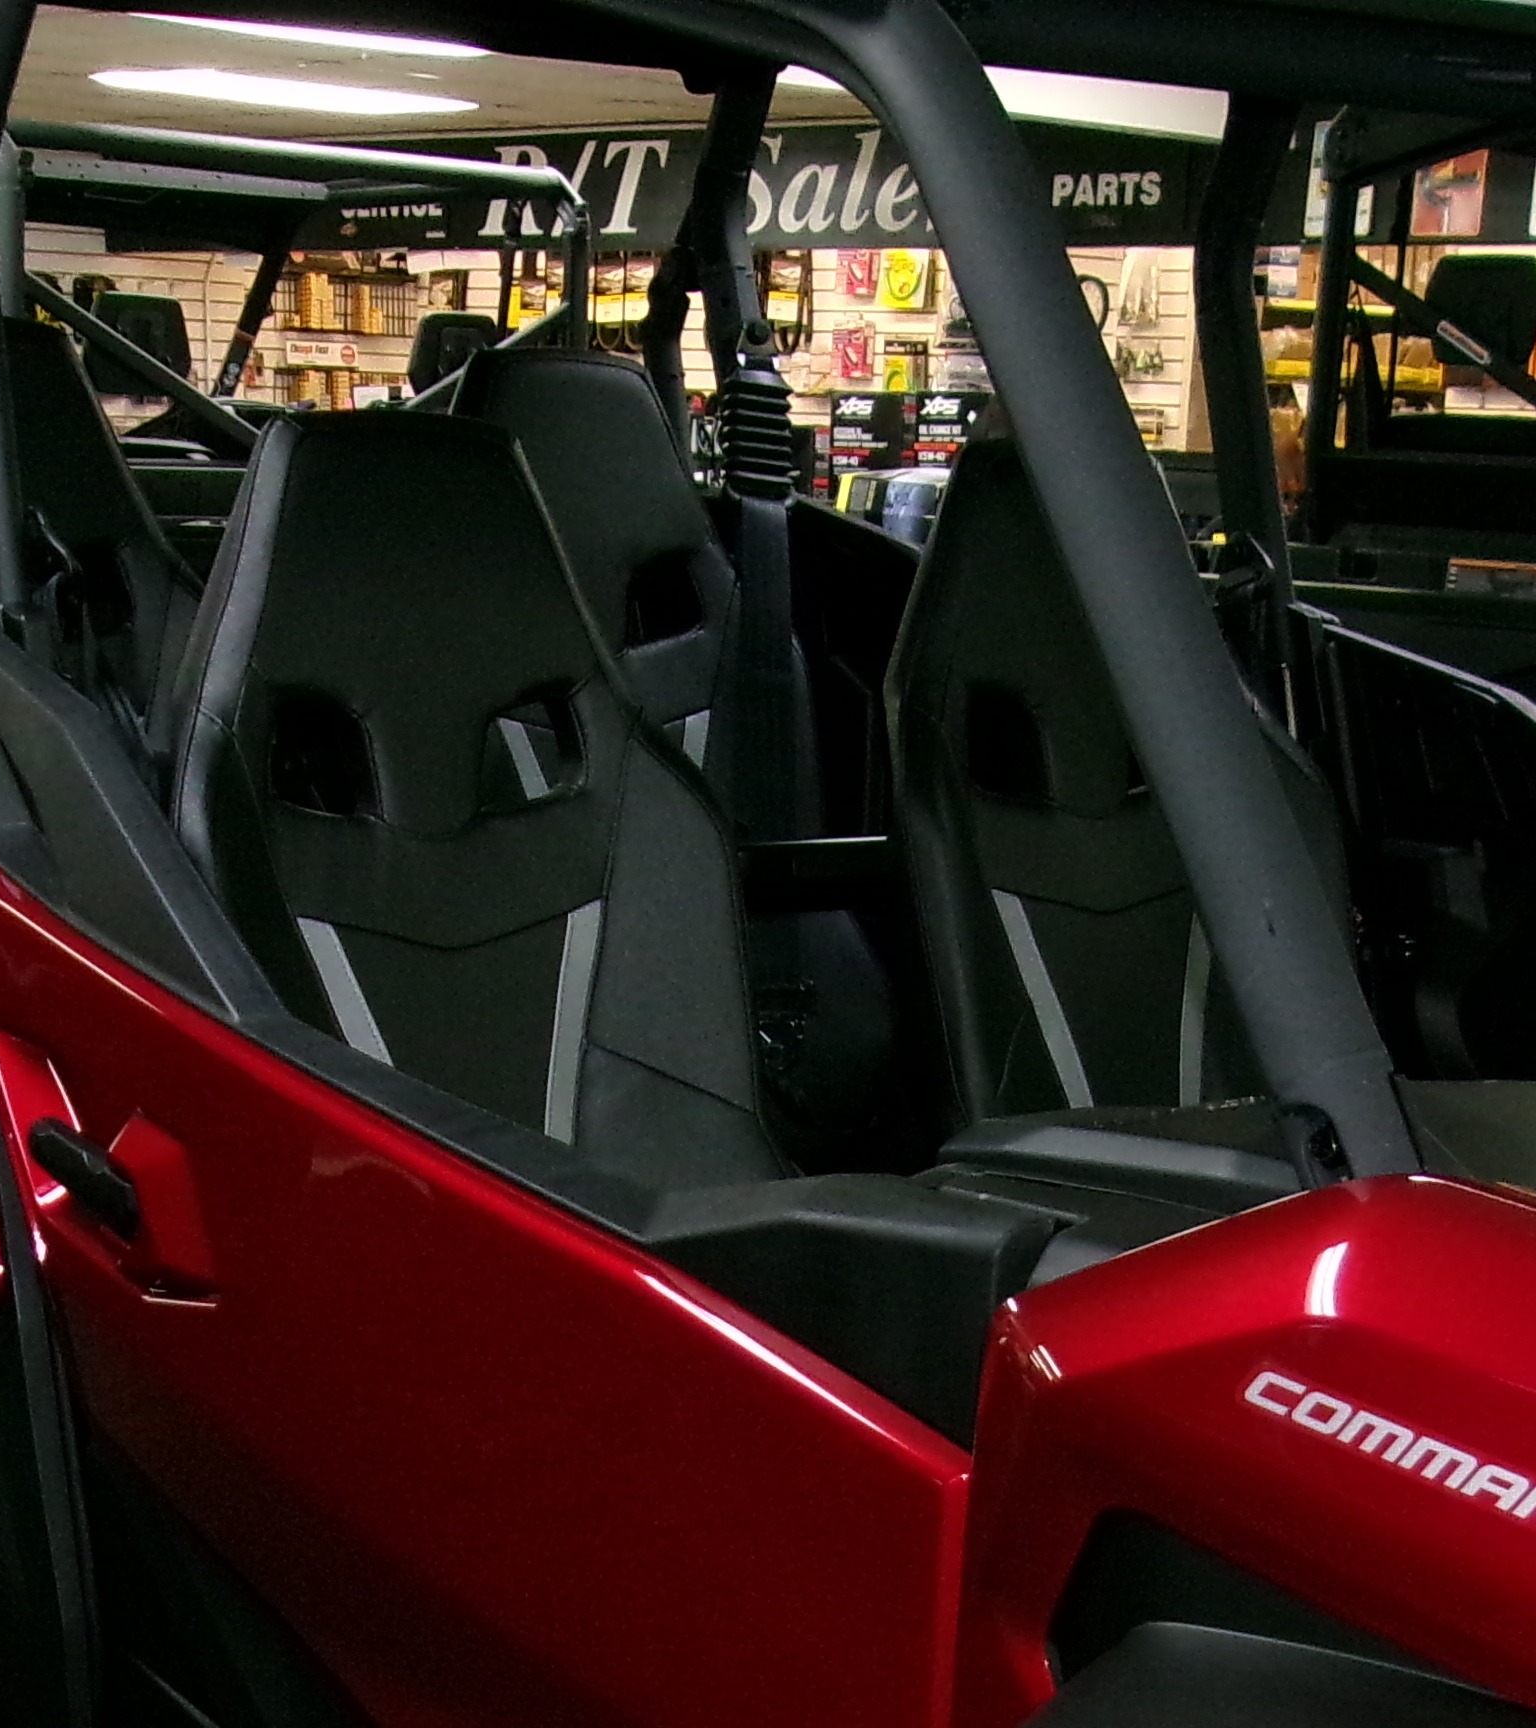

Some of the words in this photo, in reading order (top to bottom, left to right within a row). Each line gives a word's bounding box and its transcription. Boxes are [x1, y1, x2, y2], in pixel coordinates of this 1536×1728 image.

[746, 129, 936, 234] Sale
[1051, 172, 1162, 207] PARTS
[835, 397, 875, 415] XPS
[920, 396, 962, 415] XPS
